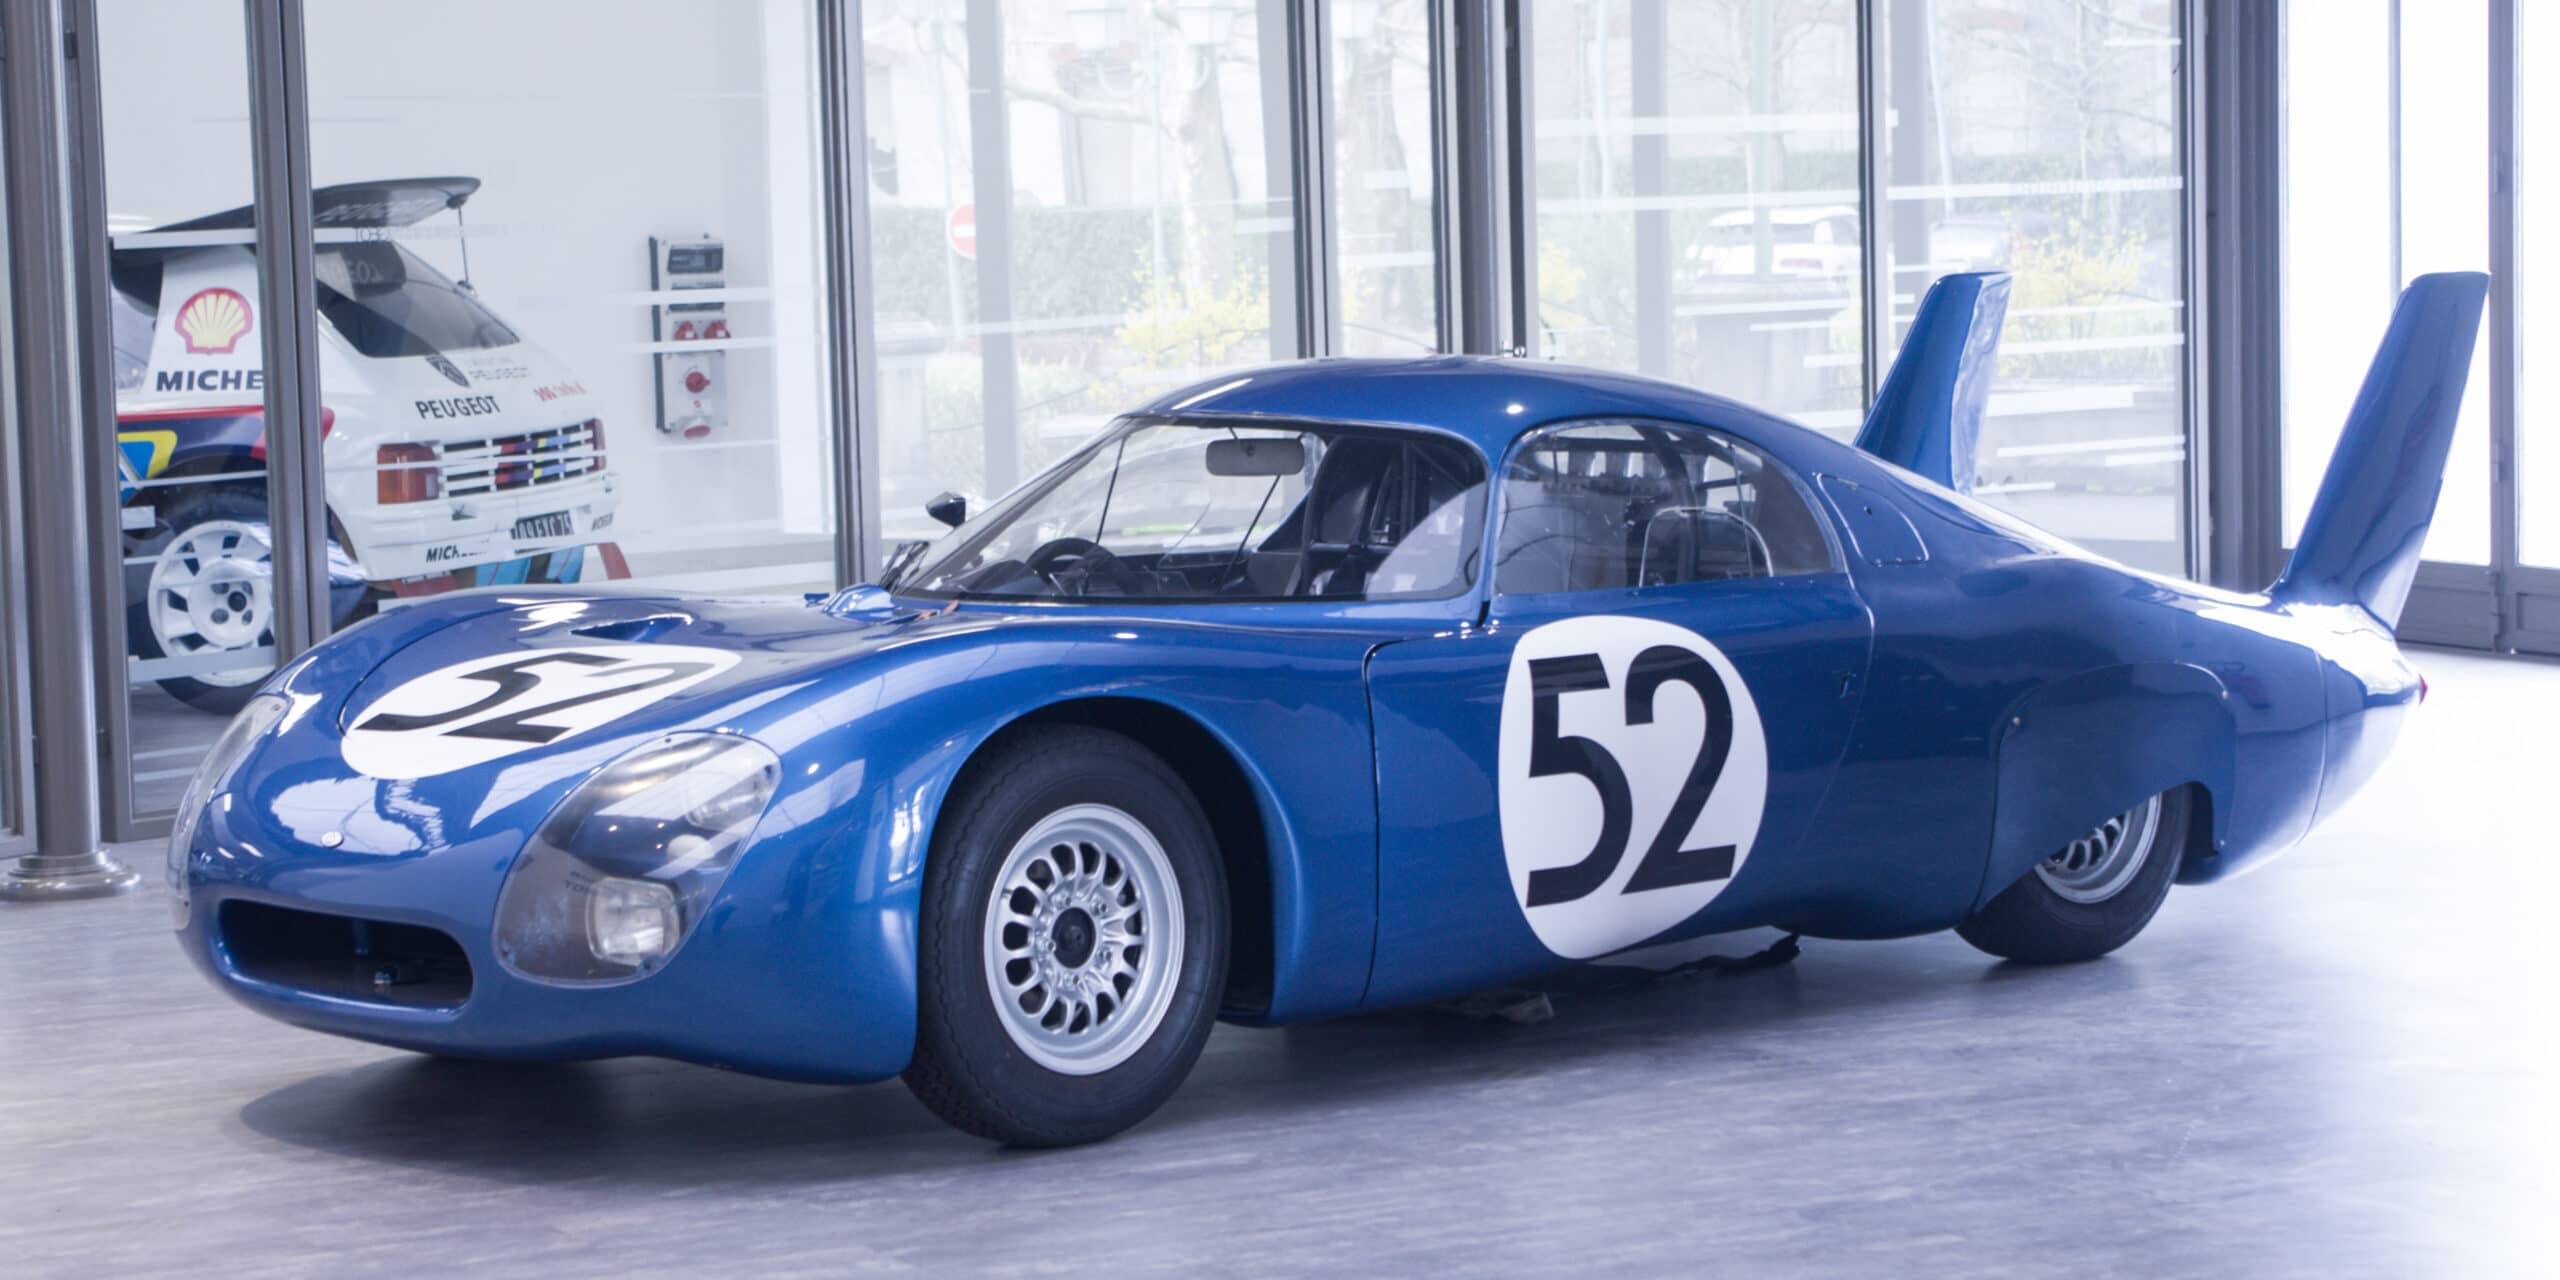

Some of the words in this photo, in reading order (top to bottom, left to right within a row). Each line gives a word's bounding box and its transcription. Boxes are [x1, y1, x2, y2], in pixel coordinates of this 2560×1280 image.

[156, 369, 264, 392] MICHE
[415, 395, 501, 420] PEUGEOT
[354, 651, 716, 744] 52
[1526, 644, 1737, 908] 52
